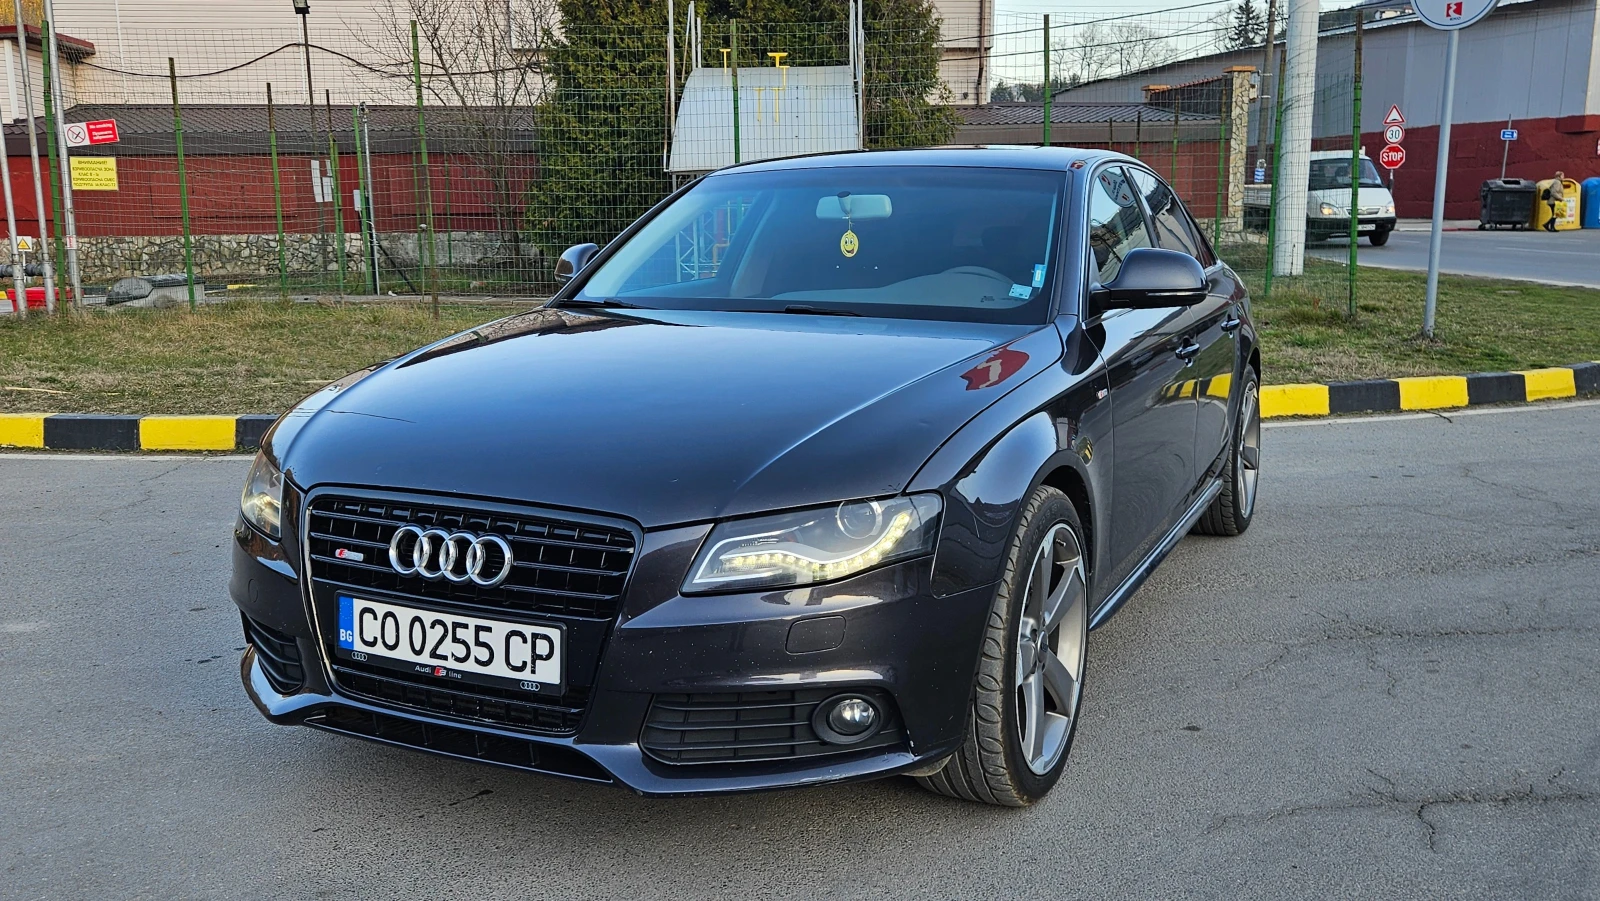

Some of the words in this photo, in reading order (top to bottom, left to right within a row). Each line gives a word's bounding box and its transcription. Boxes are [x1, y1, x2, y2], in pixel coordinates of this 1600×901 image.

[1388, 129, 1400, 140] 30
[1382, 151, 1403, 162] STOP
[339, 628, 353, 643] BG
[359, 606, 400, 652] CO
[408, 615, 495, 667] 0255
[504, 629, 555, 675] CP
[414, 665, 432, 673] Audi
[448, 670, 462, 679] line
